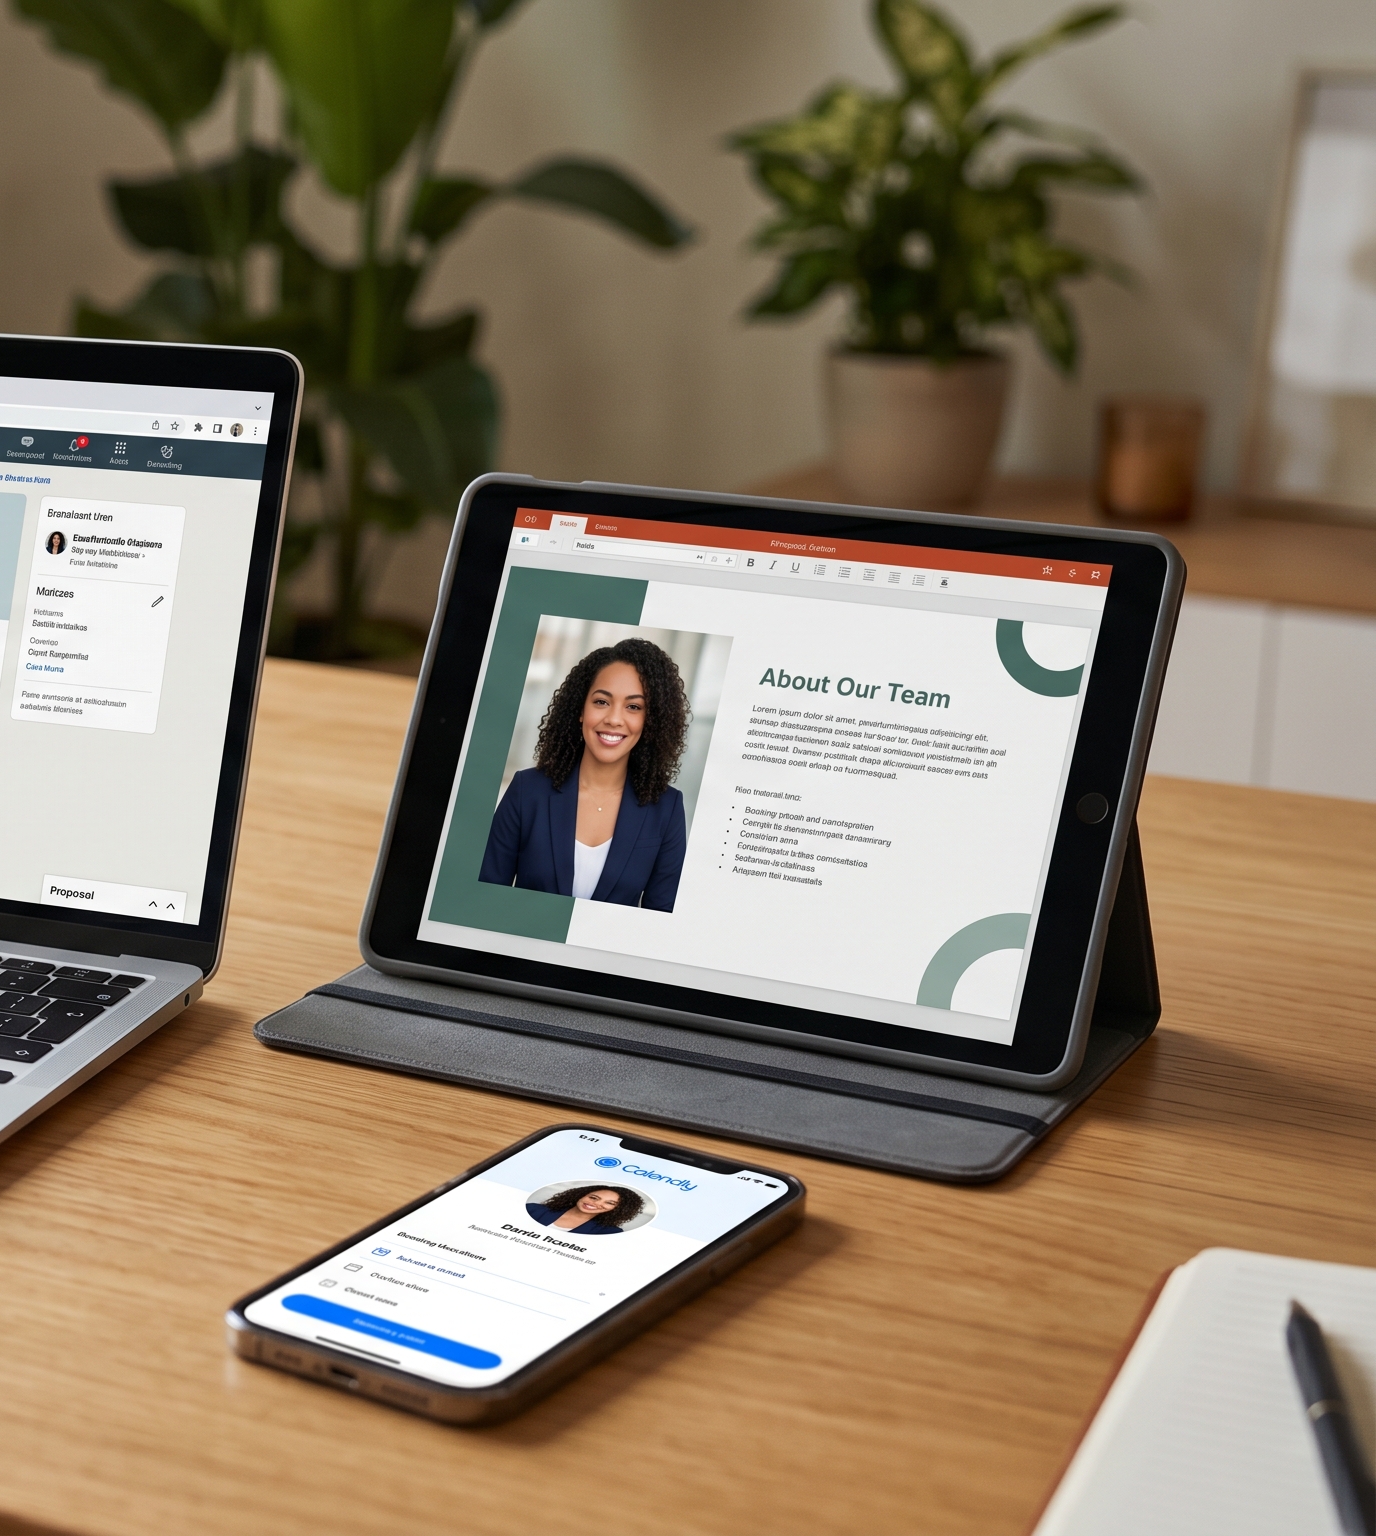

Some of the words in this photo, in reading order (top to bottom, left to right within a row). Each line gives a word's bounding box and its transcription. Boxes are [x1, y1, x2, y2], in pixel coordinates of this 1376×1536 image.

[746, 558, 755, 567] B
[769, 560, 778, 570] I
[790, 562, 801, 573] U
[759, 667, 831, 694] About
[836, 677, 881, 700] Our
[886, 682, 952, 709] Team
[752, 704, 777, 714] Lorem
[778, 707, 802, 718] ipsum
[803, 711, 824, 721] dolor
[824, 714, 834, 722] sit
[805, 816, 821, 824] and
[49, 885, 95, 900] Proposal
[621, 1164, 698, 1193] Calendly
